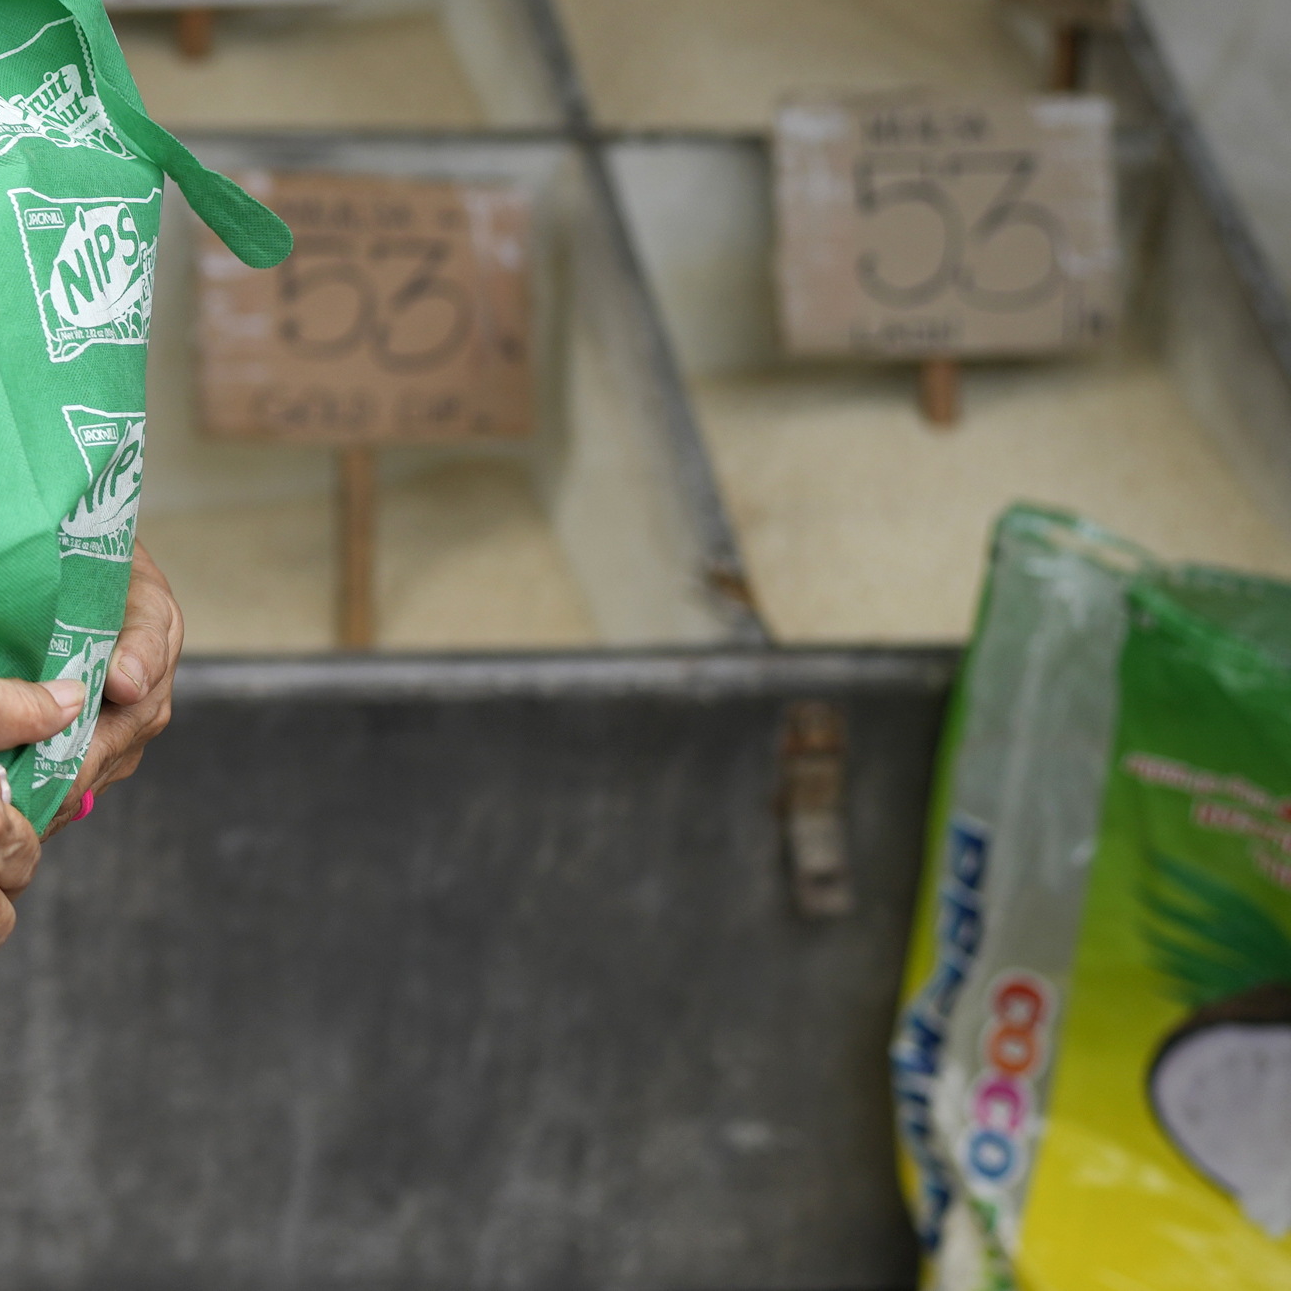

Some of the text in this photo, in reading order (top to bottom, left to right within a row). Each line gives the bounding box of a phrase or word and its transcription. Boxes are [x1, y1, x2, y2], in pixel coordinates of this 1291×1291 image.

[12, 70, 72, 121] Fruit
[42, 92, 88, 128] Nut
[275, 230, 472, 377] 53
[853, 151, 1071, 313] 53
[967, 976, 1051, 1187] COCO
